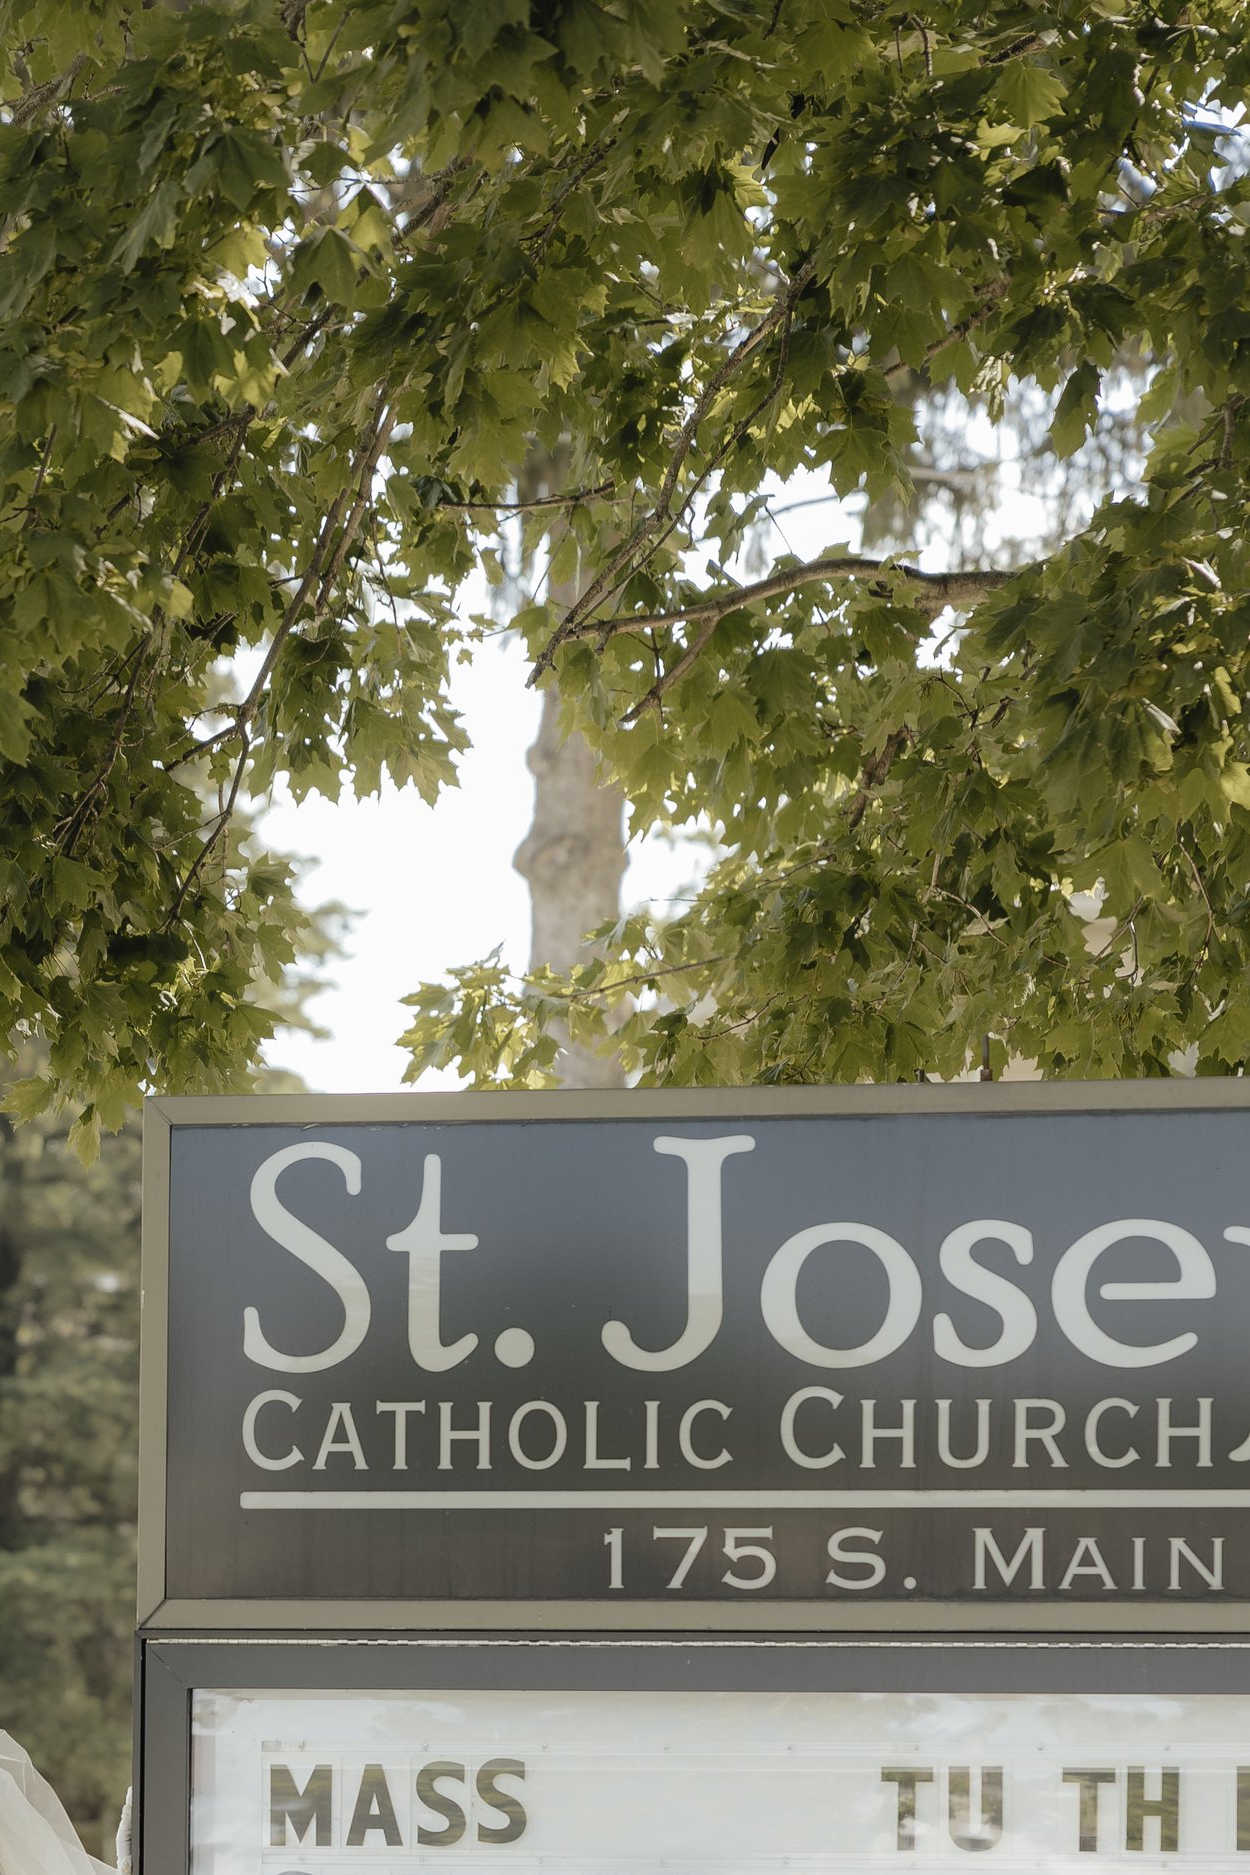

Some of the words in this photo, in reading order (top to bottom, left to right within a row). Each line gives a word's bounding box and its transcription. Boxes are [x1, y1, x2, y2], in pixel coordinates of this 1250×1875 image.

[244, 1141, 535, 1373] St.
[601, 1135, 1250, 1462] Jose
[242, 1388, 734, 1471] CATHOLIC
[780, 1386, 1214, 1469] CHURCH
[602, 1526, 778, 1590] 175
[826, 1526, 919, 1591] S.
[971, 1527, 1226, 1592] MAIN
[268, 1758, 528, 1847] MASS
[881, 1766, 1003, 1852] TU
[1062, 1766, 1180, 1851] TH
